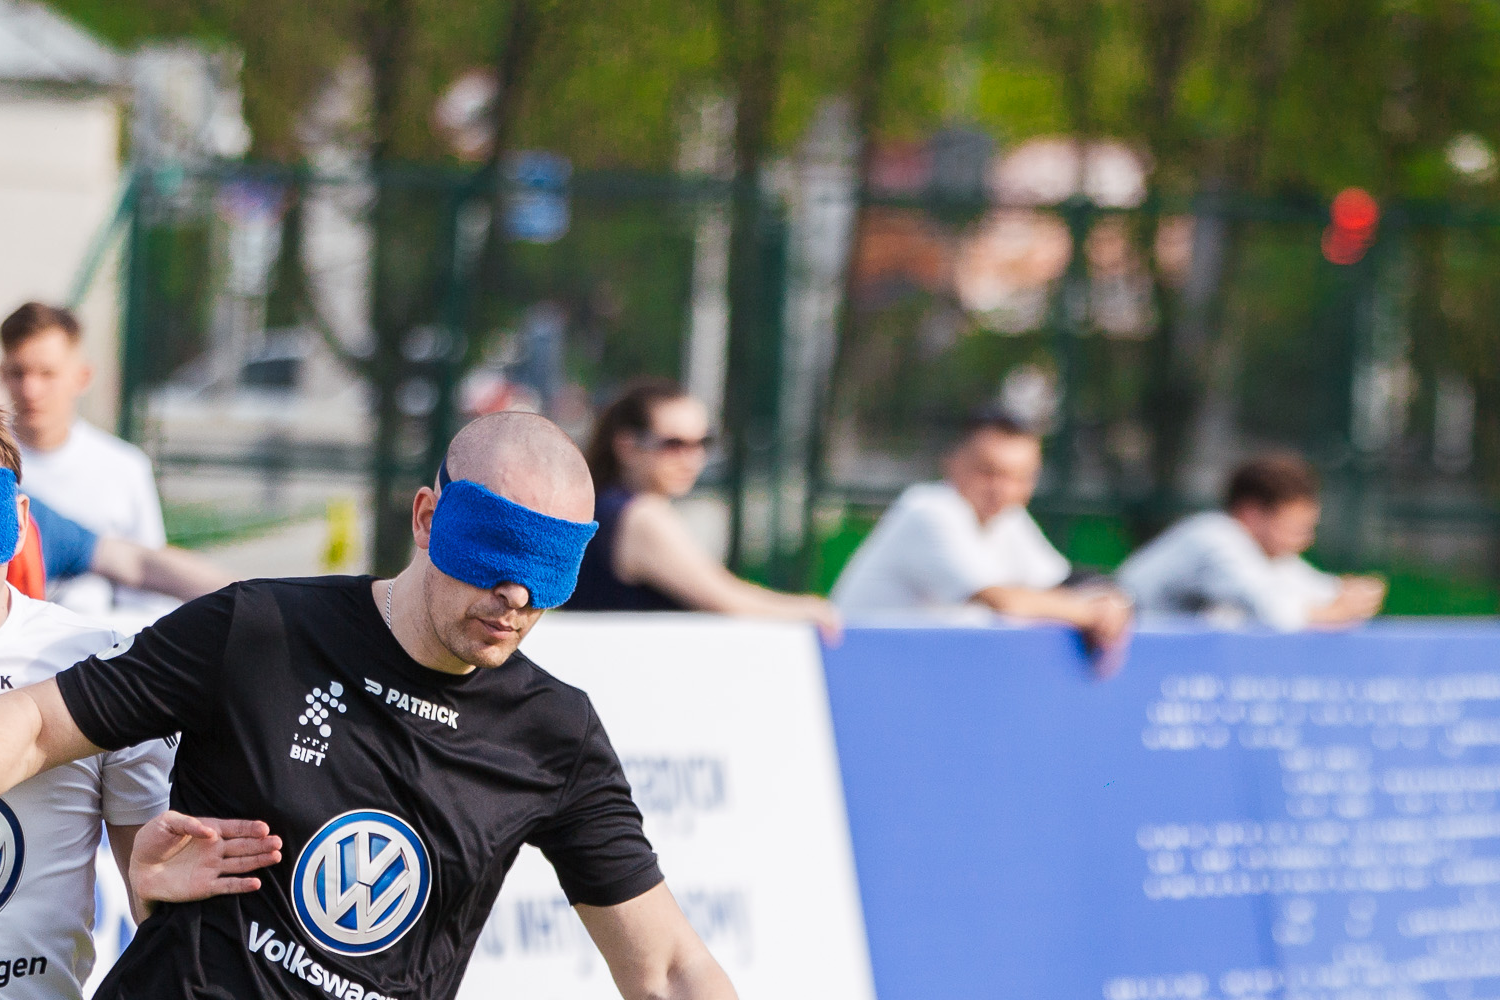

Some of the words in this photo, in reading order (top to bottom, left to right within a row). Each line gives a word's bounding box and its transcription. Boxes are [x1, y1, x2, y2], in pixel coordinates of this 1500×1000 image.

[385, 688, 460, 730] PATRICK
[289, 744, 326, 767] BIFT
[302, 820, 421, 946] VW
